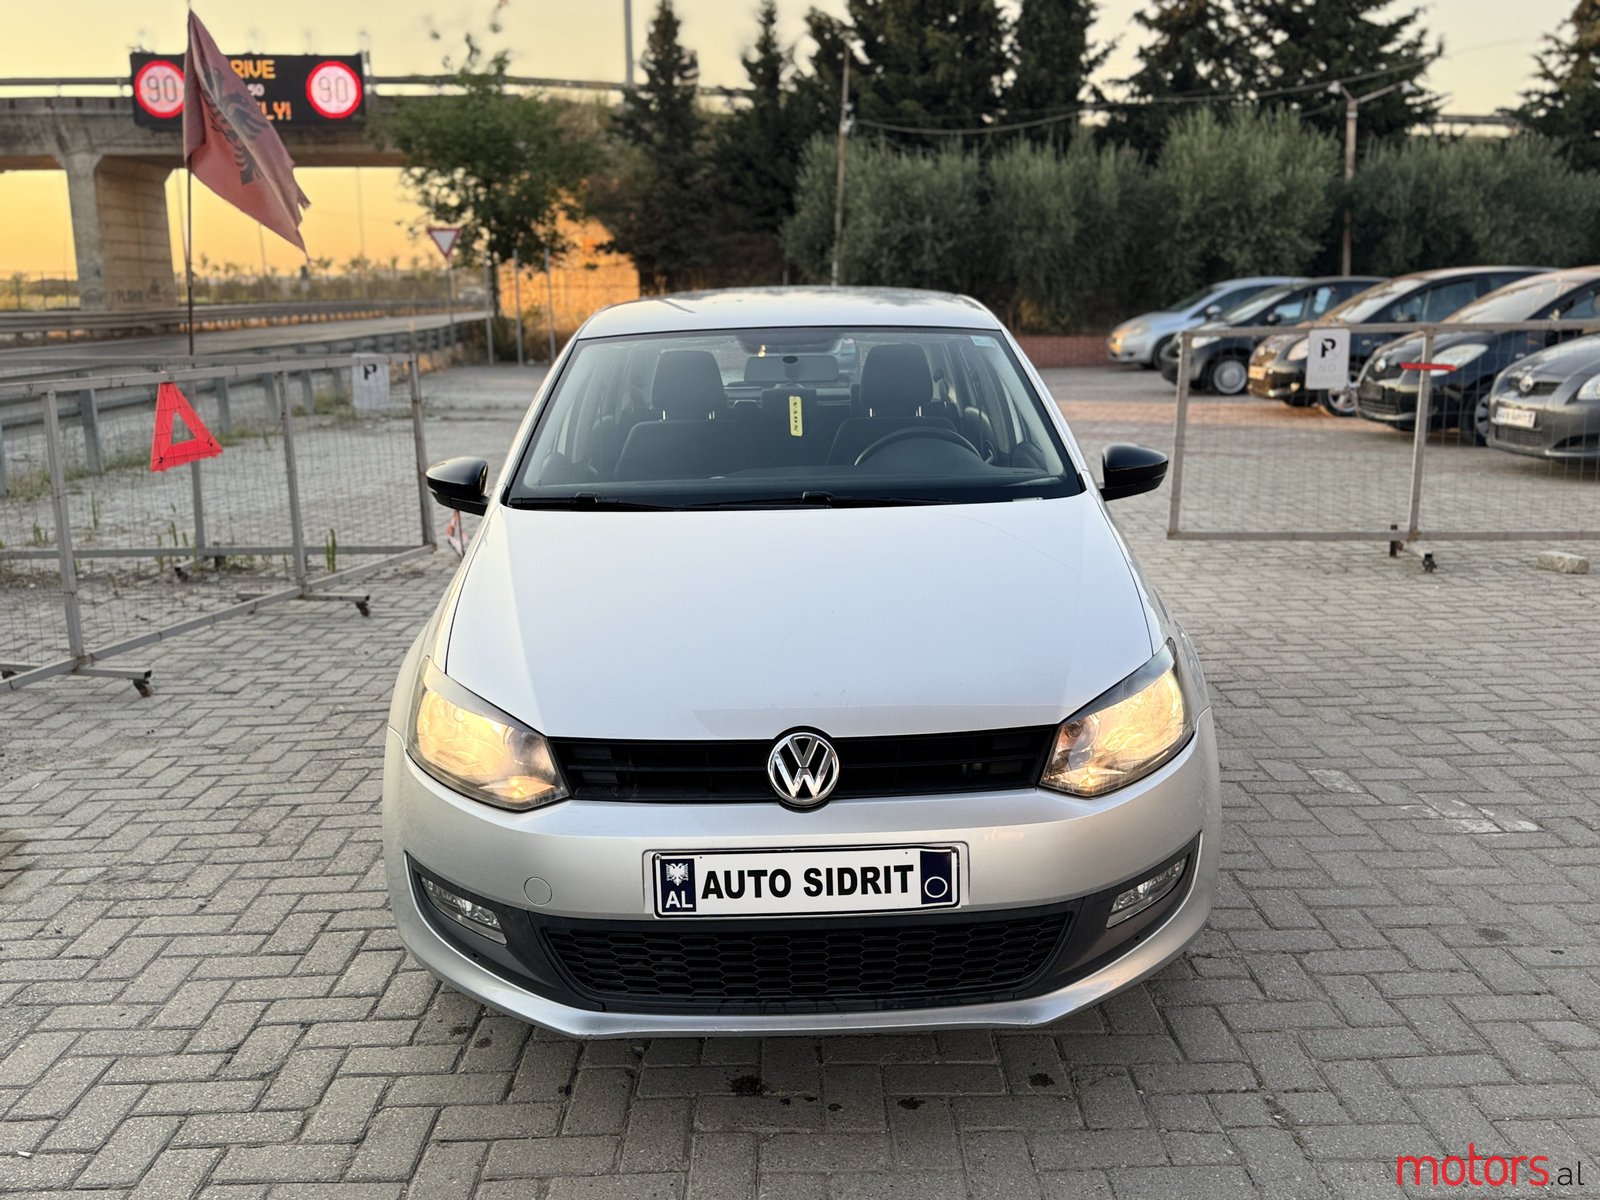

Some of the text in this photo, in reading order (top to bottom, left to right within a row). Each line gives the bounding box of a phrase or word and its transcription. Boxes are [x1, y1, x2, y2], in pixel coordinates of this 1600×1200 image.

[231, 59, 276, 79] RIVE
[146, 75, 178, 103] 90
[318, 75, 348, 104] 90
[257, 101, 292, 121] LY!
[1321, 338, 1336, 358] P
[665, 864, 914, 909] AL AUTO SIDRIT
